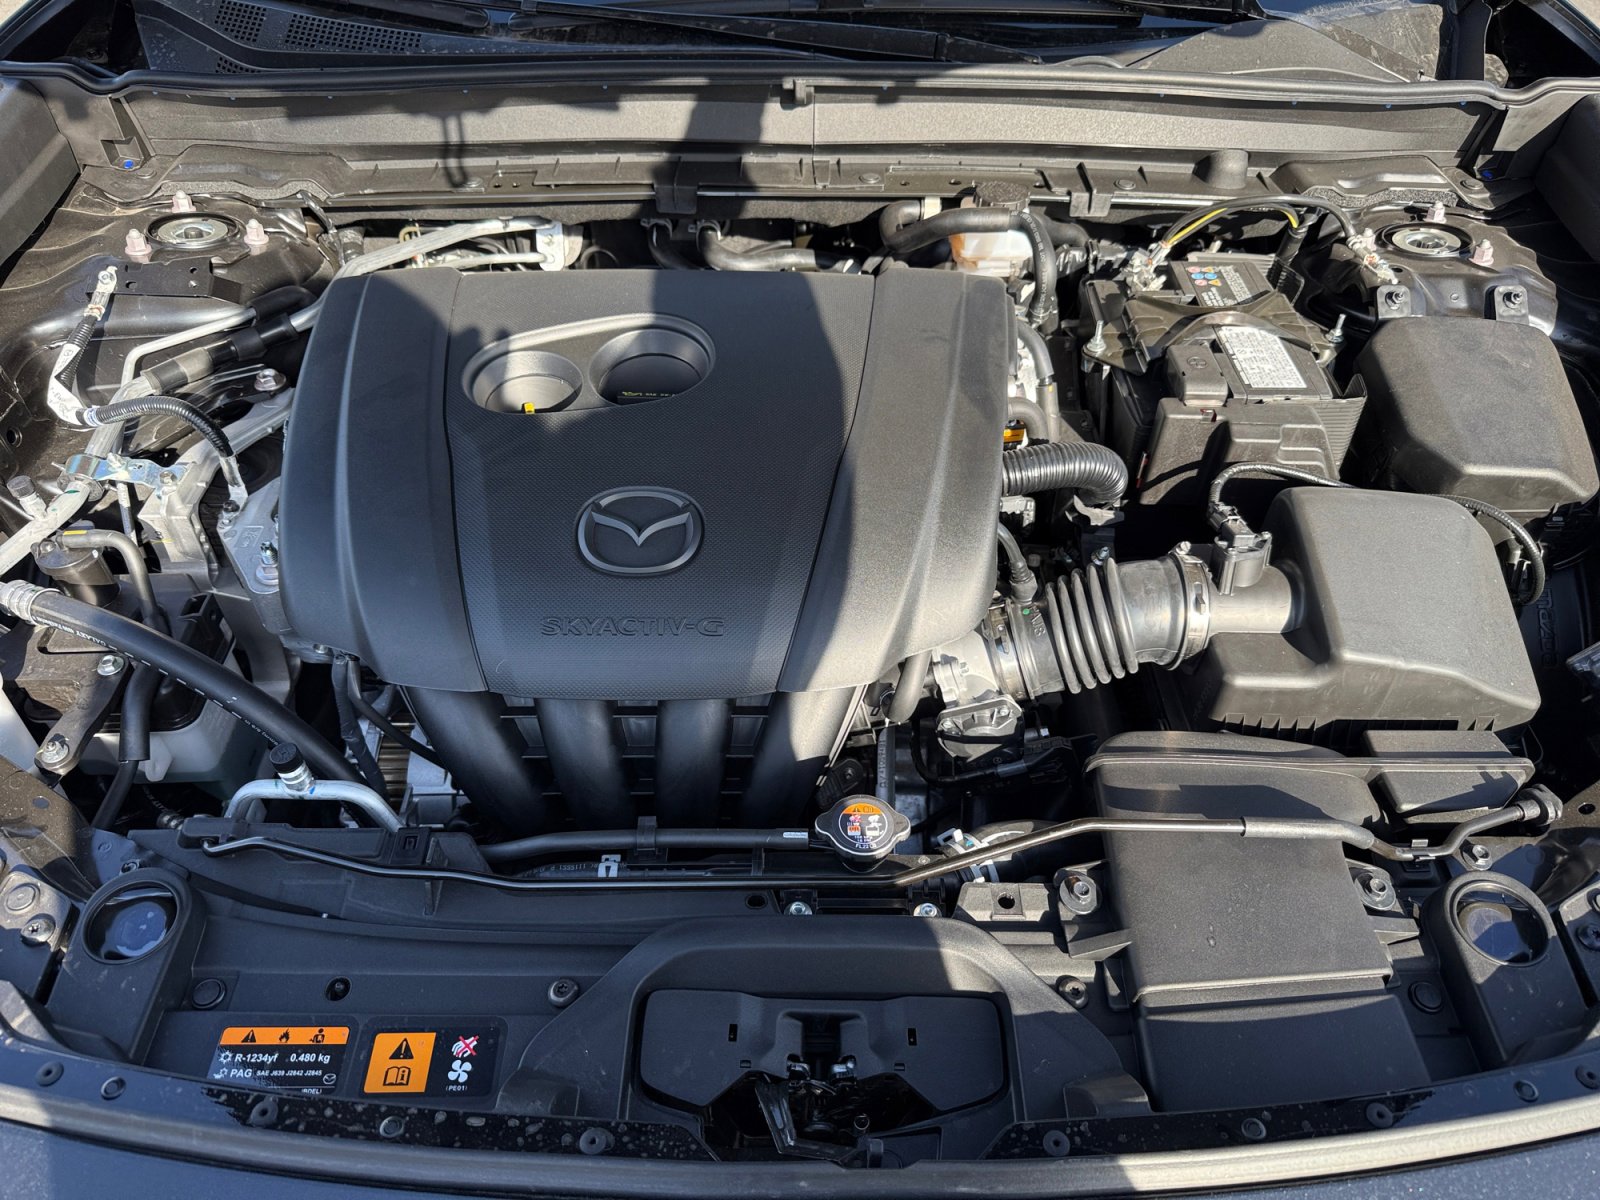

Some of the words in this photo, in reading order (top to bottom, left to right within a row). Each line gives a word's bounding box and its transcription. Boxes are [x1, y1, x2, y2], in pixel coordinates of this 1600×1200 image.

[541, 616, 725, 636] SKYACTIV-G
[234, 1053, 278, 1065] R-1234yf
[289, 1053, 316, 1063] 0.480
[317, 1053, 331, 1064] kg
[229, 1068, 253, 1078] PAG
